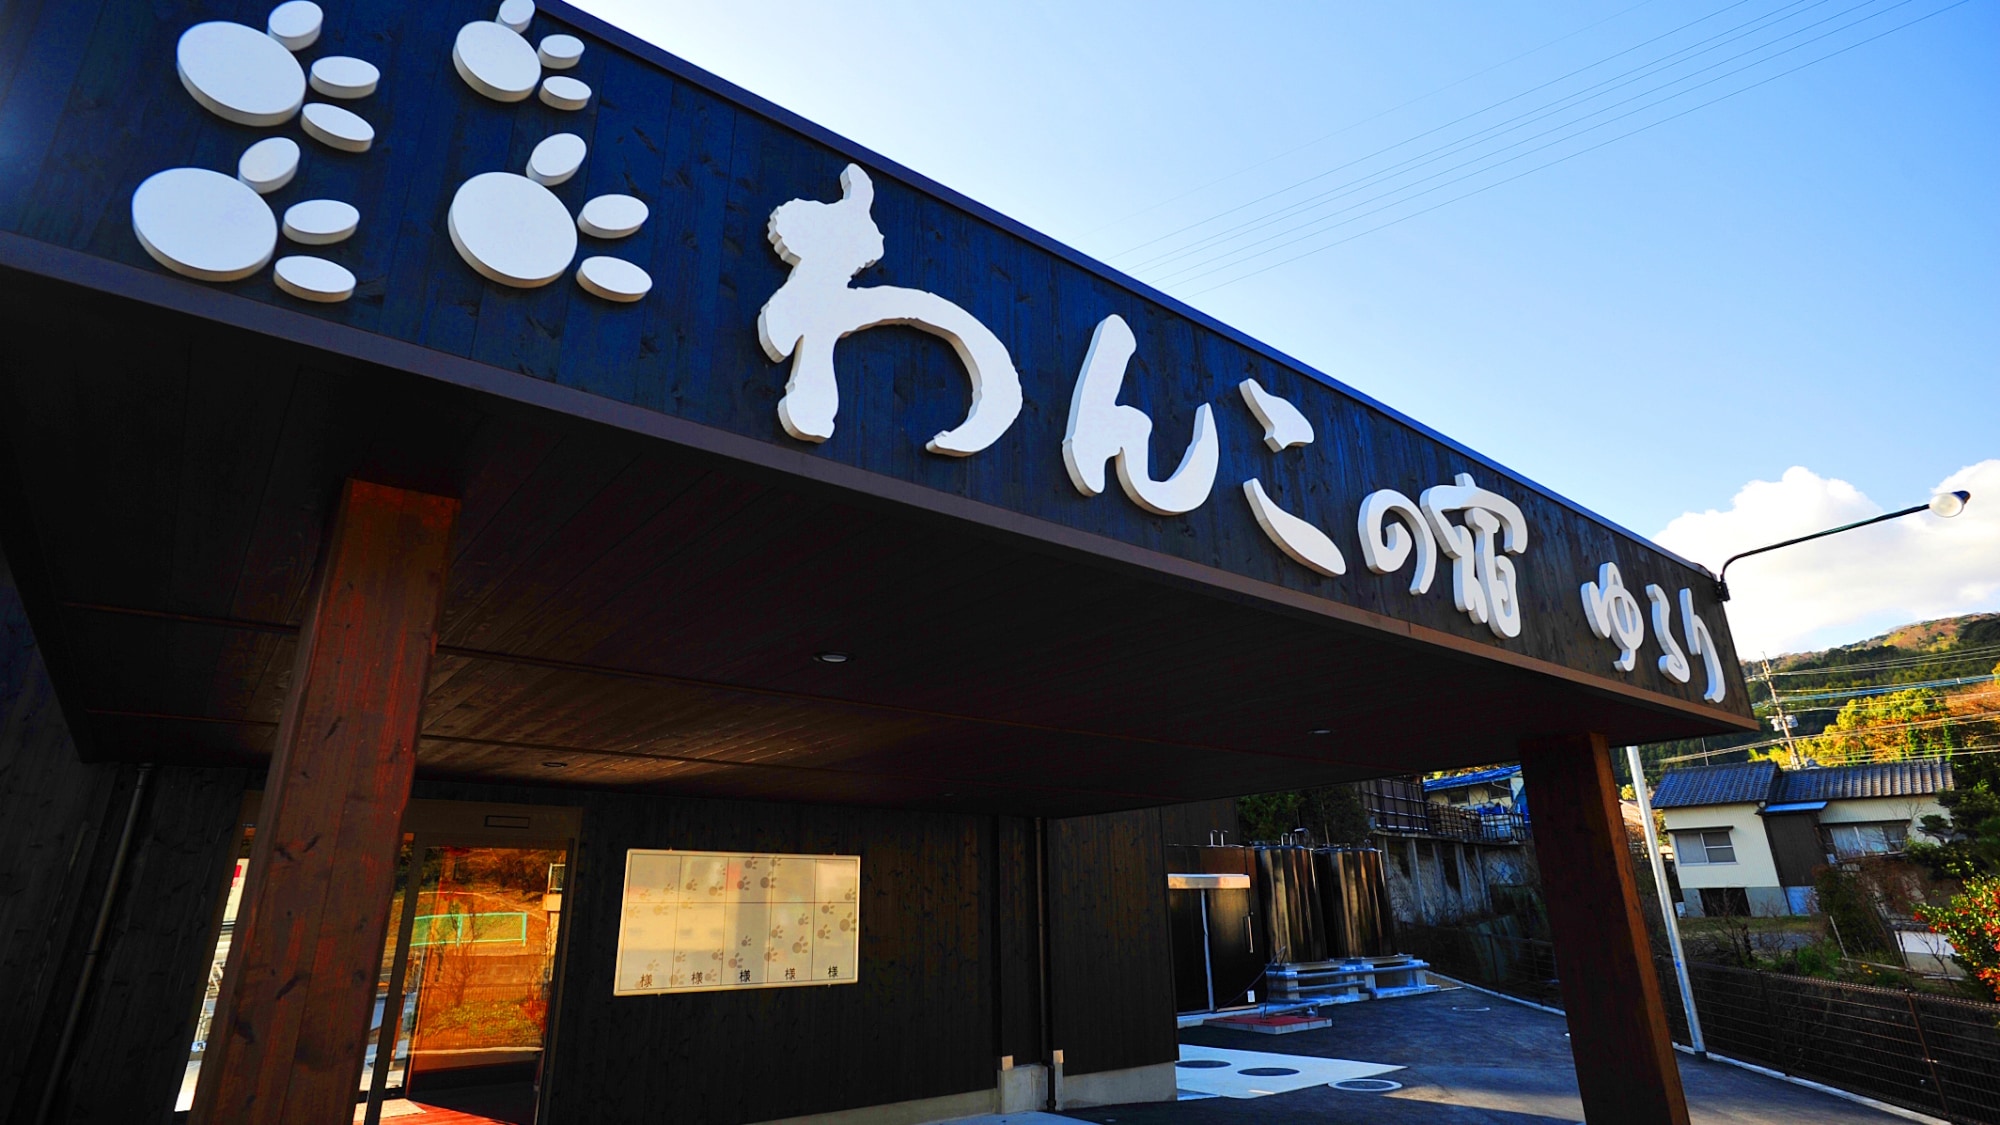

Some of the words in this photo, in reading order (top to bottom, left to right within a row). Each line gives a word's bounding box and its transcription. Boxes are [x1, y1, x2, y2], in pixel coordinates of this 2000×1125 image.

[758, 163, 1527, 638] わんこの宿
[1581, 562, 1726, 703] ゆるり
